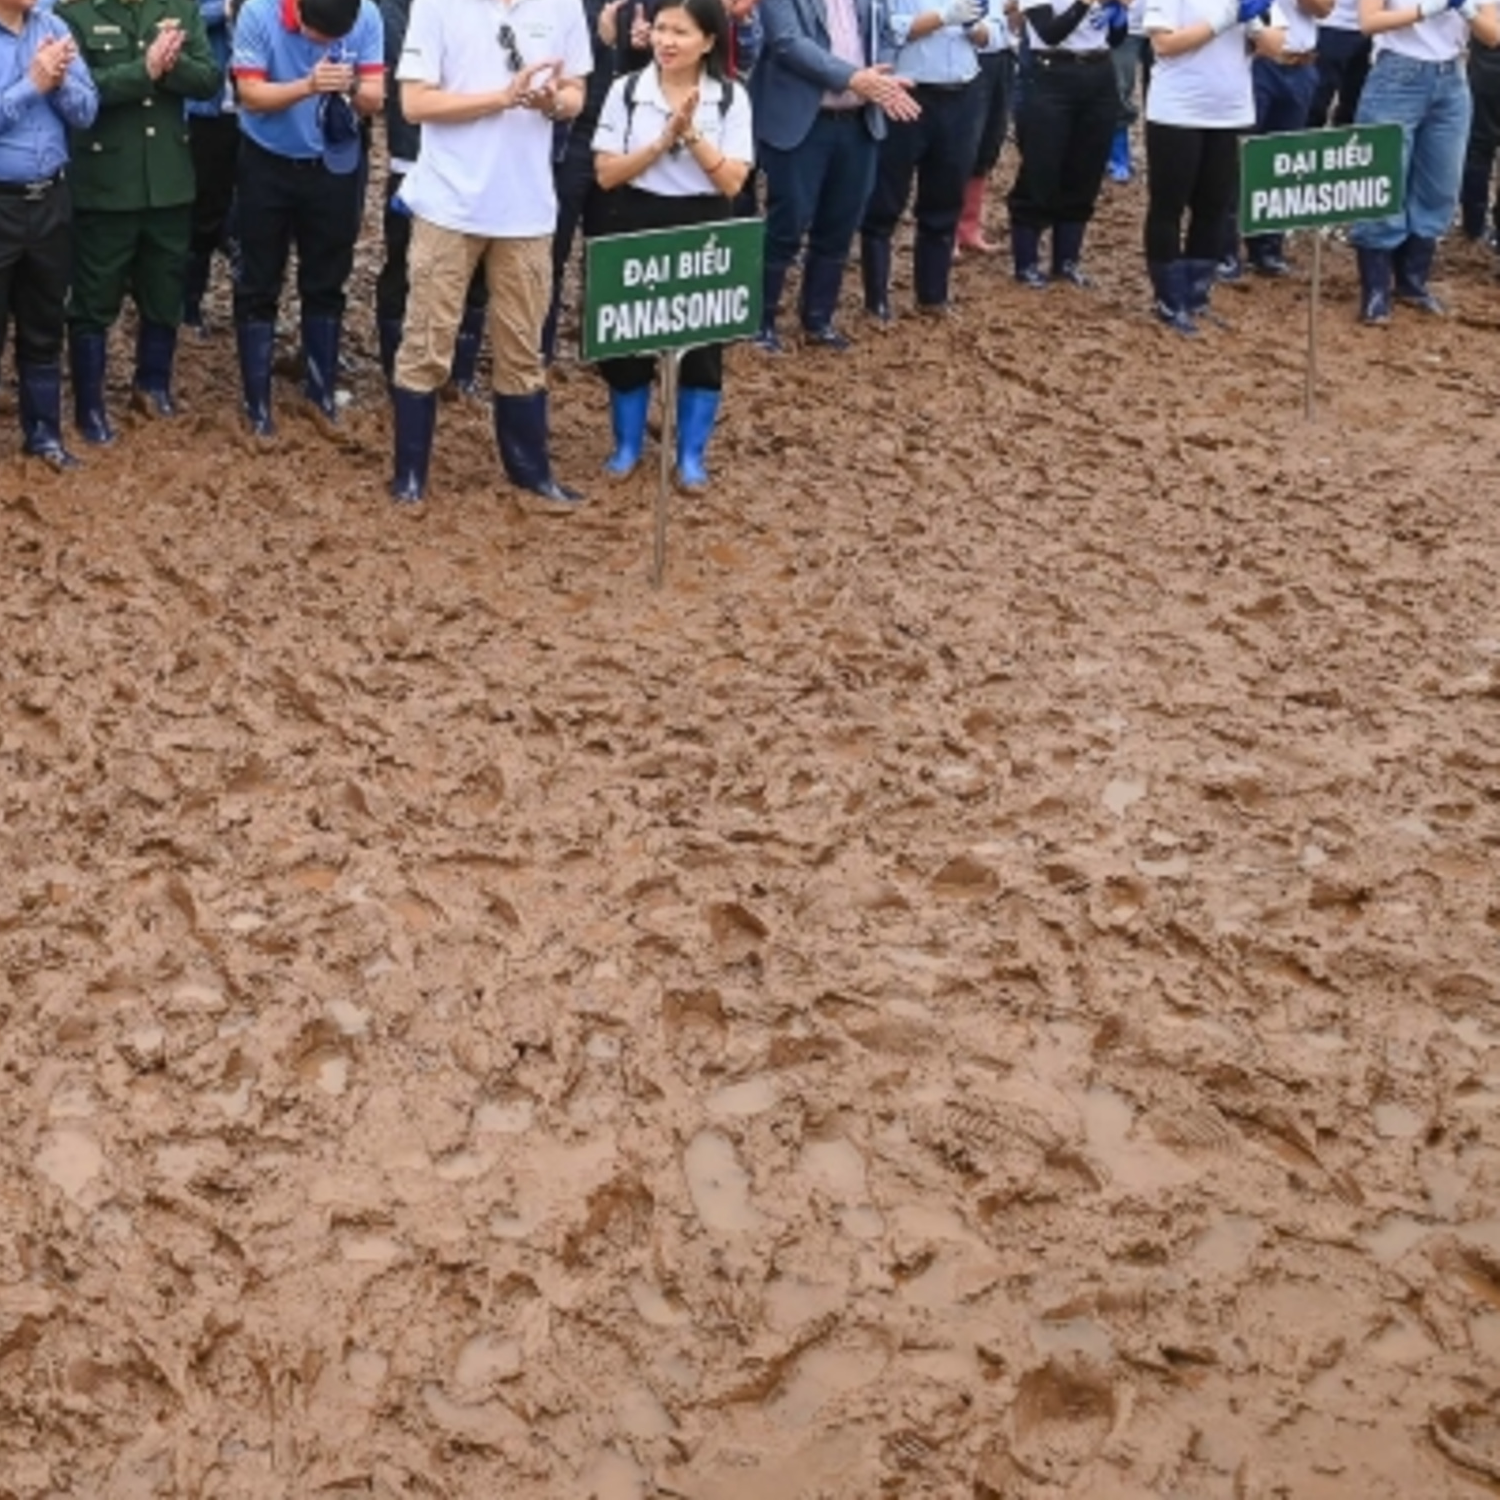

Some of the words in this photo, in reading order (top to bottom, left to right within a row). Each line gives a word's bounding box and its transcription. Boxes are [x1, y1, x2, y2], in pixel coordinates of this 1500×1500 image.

[1273, 149, 1317, 181] ĐẠI
[1252, 176, 1391, 221] PANASONIC
[623, 254, 670, 291] ĐẠI
[677, 233, 731, 279] BIỂU
[597, 286, 749, 343] PANASONIC
